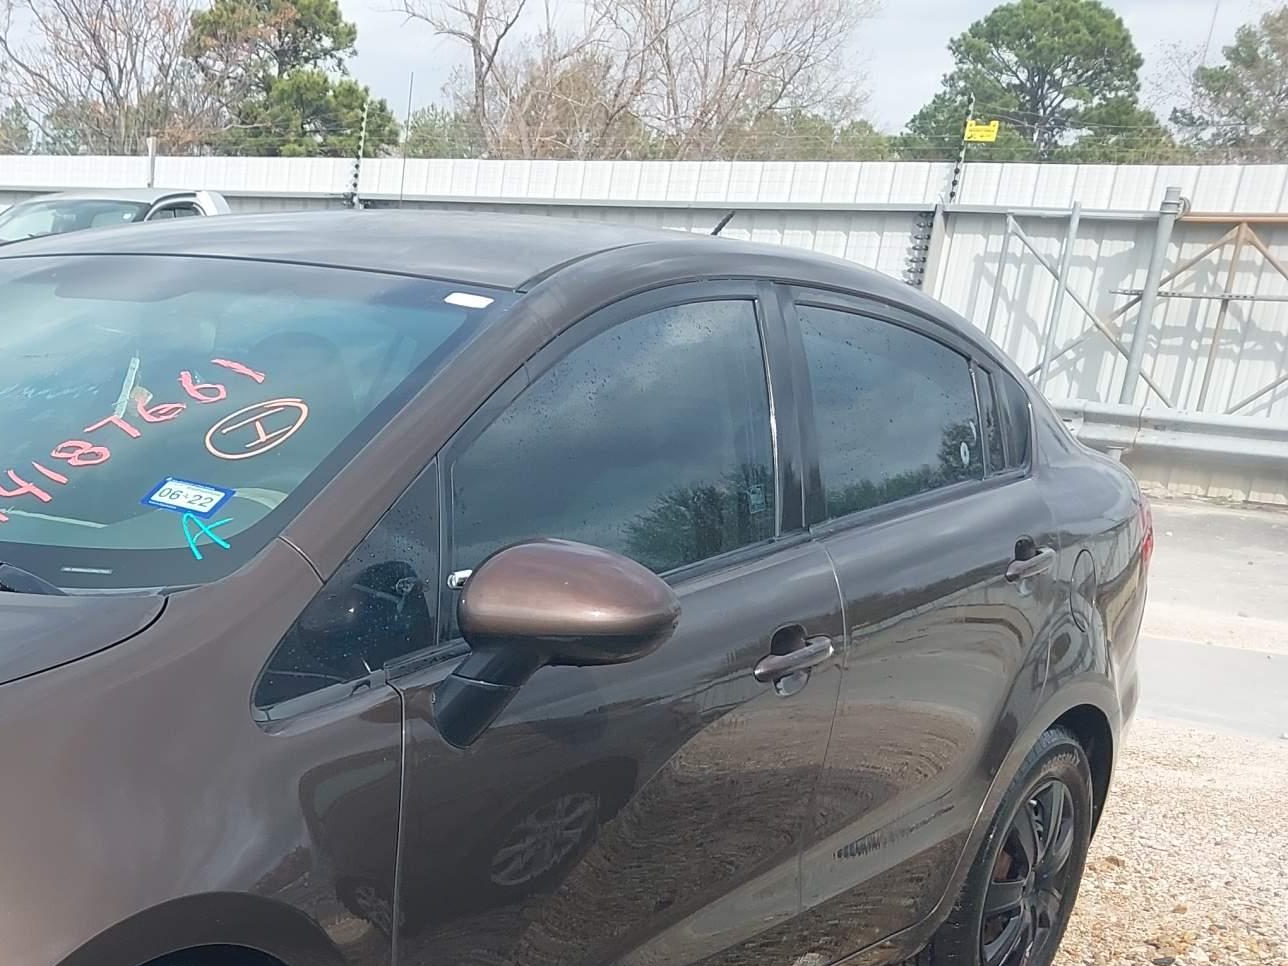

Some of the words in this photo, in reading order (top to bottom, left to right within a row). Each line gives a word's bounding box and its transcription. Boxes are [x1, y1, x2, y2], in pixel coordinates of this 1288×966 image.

[158, 487, 184, 500] 06
[187, 494, 215, 508] 22
[181, 511, 235, 561] A
